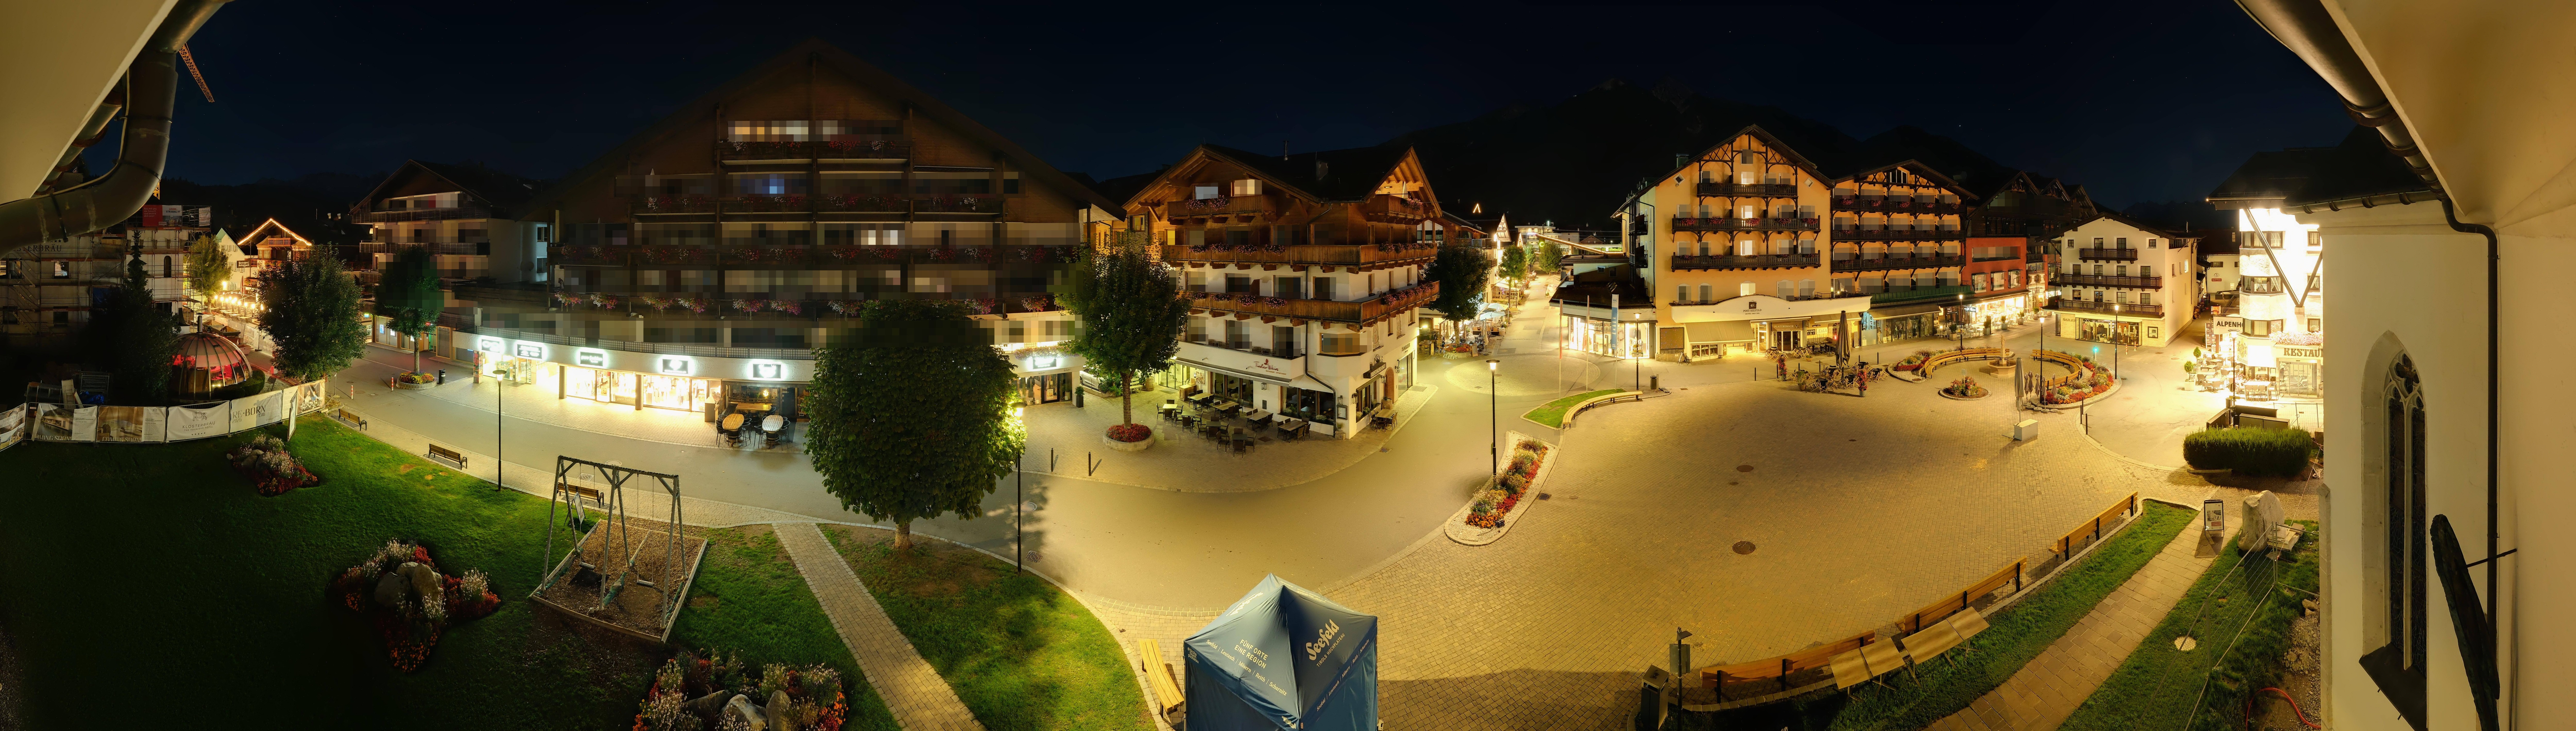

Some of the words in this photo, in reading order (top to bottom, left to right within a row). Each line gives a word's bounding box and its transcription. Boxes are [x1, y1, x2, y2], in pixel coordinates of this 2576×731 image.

[1402, 343, 1410, 351] SAILER
[1371, 364, 1385, 377] RESTAURANT
[1240, 639, 1254, 651] FÜNF
[1253, 648, 1268, 661] ORTE
[1306, 619, 1339, 660] Seefeld
[1317, 654, 1327, 667] TIROLS
[1327, 633, 1345, 655] HOCHPLATEAU
[1188, 654, 1199, 664] plateau
[1206, 640, 1218, 649] Seefeld
[1221, 649, 1235, 661] Leutasch
[1238, 661, 1251, 673] Mösern
[1255, 673, 1266, 682] Reith
[1269, 682, 1287, 696] Scharnitz
[1234, 645, 1247, 656] EINE
[1246, 653, 1266, 669] REGION
[1317, 697, 1326, 711] Seefeld
[1329, 680, 1339, 696] Leutasch
[1342, 666, 1350, 678] Mösern
[1360, 639, 1369, 653] Scharnitz
